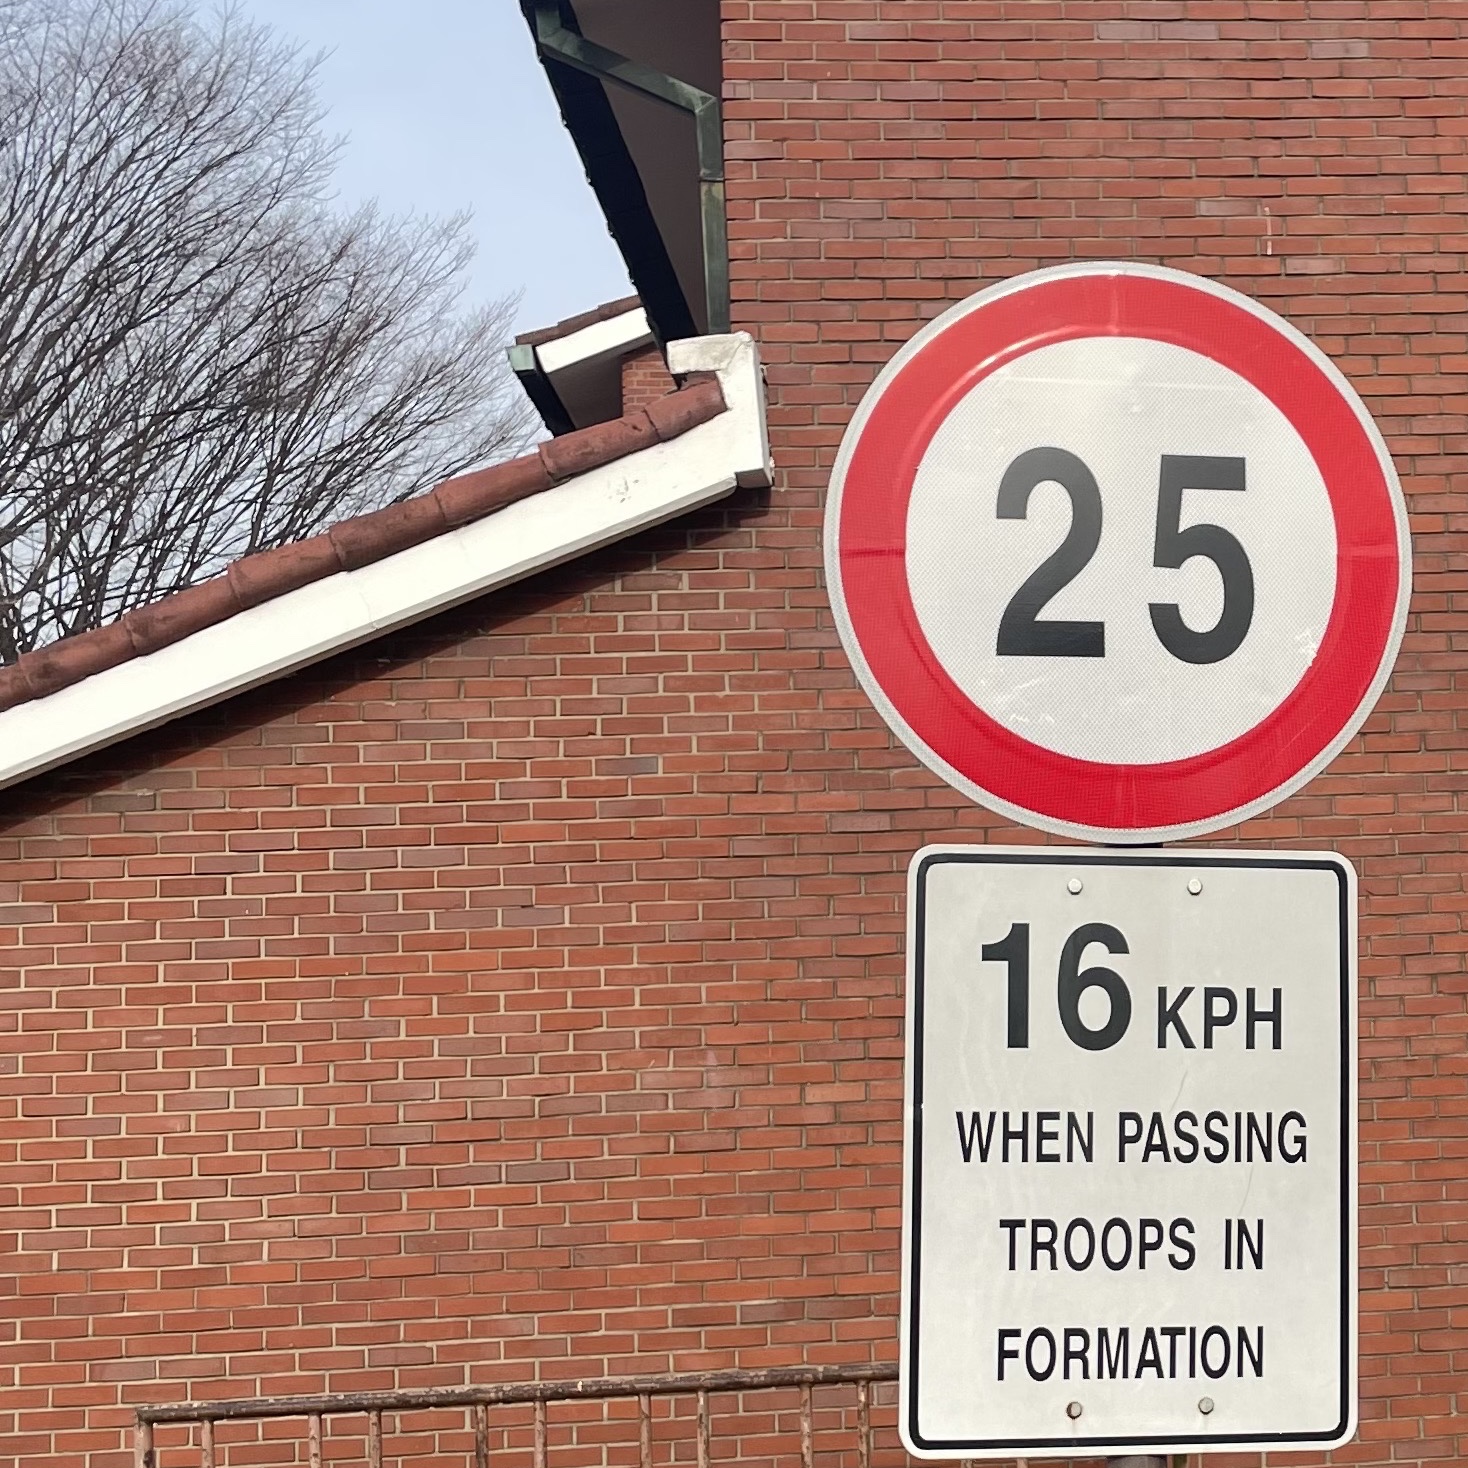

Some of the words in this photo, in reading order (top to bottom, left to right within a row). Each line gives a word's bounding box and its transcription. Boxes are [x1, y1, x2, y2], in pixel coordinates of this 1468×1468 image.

[996, 447, 1254, 664] 25
[981, 923, 1132, 1051] 16
[1157, 986, 1283, 1050] KPH
[956, 1111, 1094, 1163] WHEN
[1118, 1111, 1307, 1163] PASSING
[1000, 1218, 1196, 1271] TROOPS
[1224, 1218, 1264, 1270] IN
[997, 1326, 1264, 1381] FORMATION
